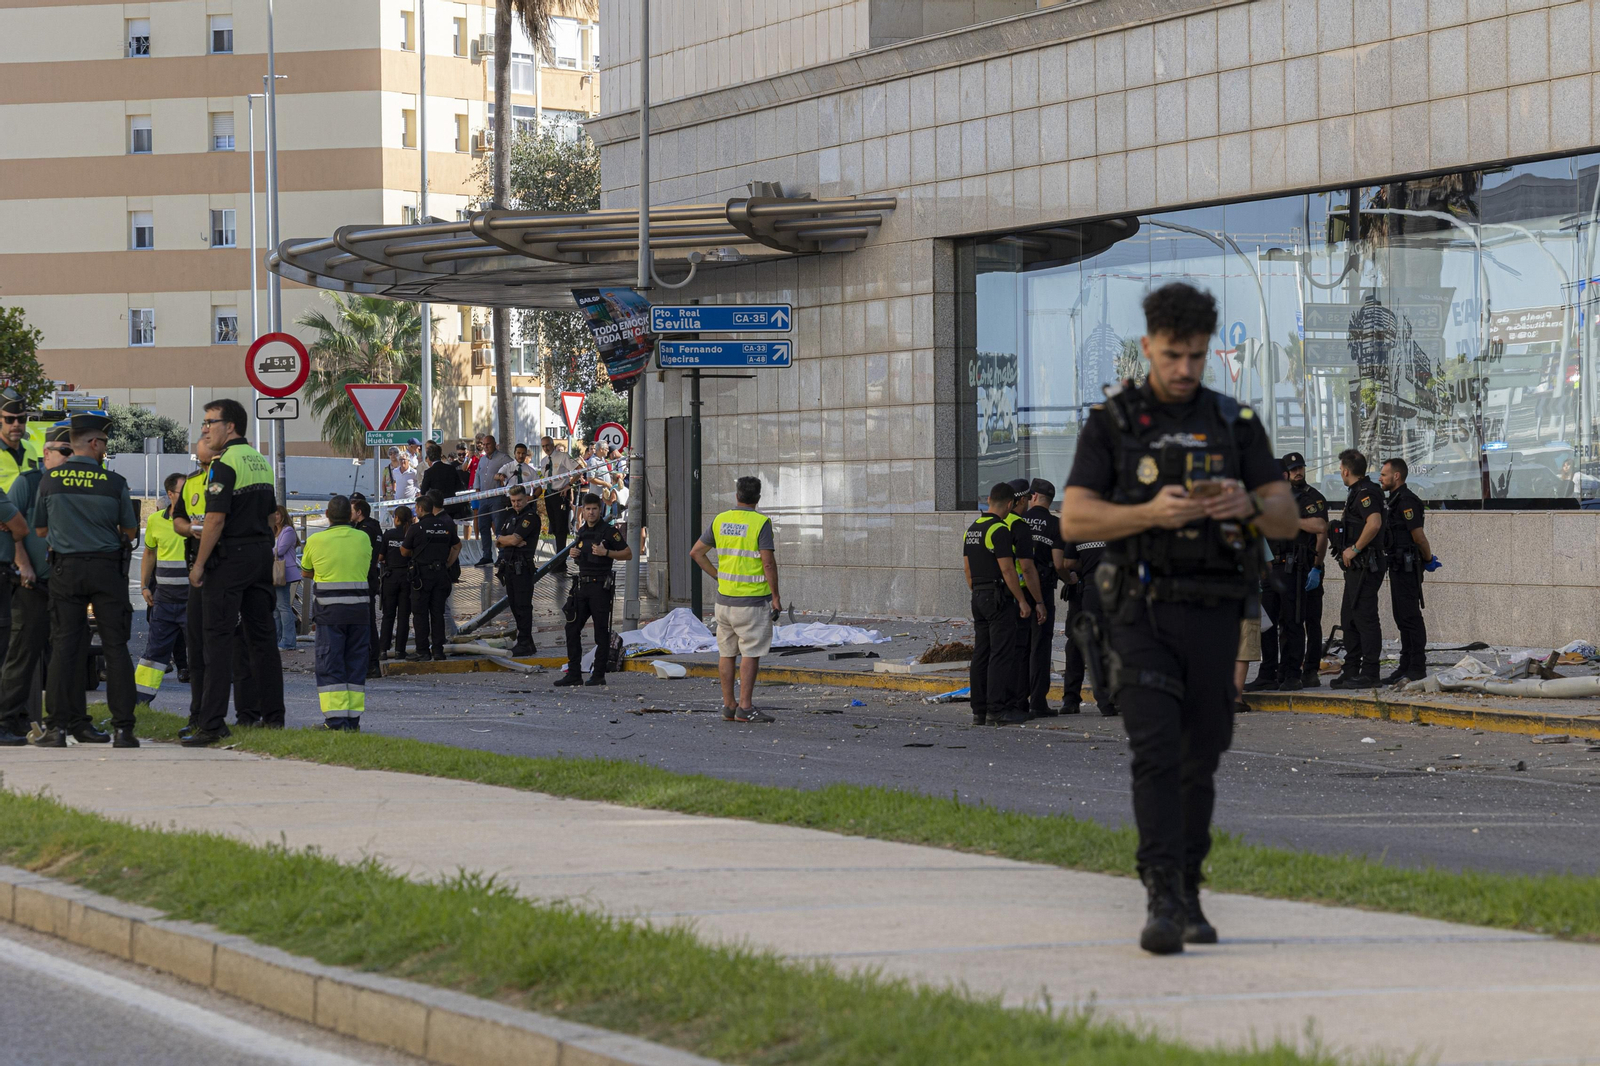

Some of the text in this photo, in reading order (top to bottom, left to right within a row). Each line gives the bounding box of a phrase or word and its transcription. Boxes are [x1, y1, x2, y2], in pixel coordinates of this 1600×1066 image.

[655, 309, 700, 317] Pto. Real
[655, 318, 701, 329] Sevilla
[735, 314, 766, 323] CA-35
[593, 323, 618, 336] TODO
[597, 333, 621, 345] TODA
[622, 329, 634, 340] EN
[661, 345, 723, 353] San Fernando
[274, 357, 294, 367] 5,5 t
[661, 355, 700, 364] Algeciras
[602, 434, 621, 445] 40
[50, 470, 108, 481] GUARDIA
[62, 478, 94, 488] CIVIL
